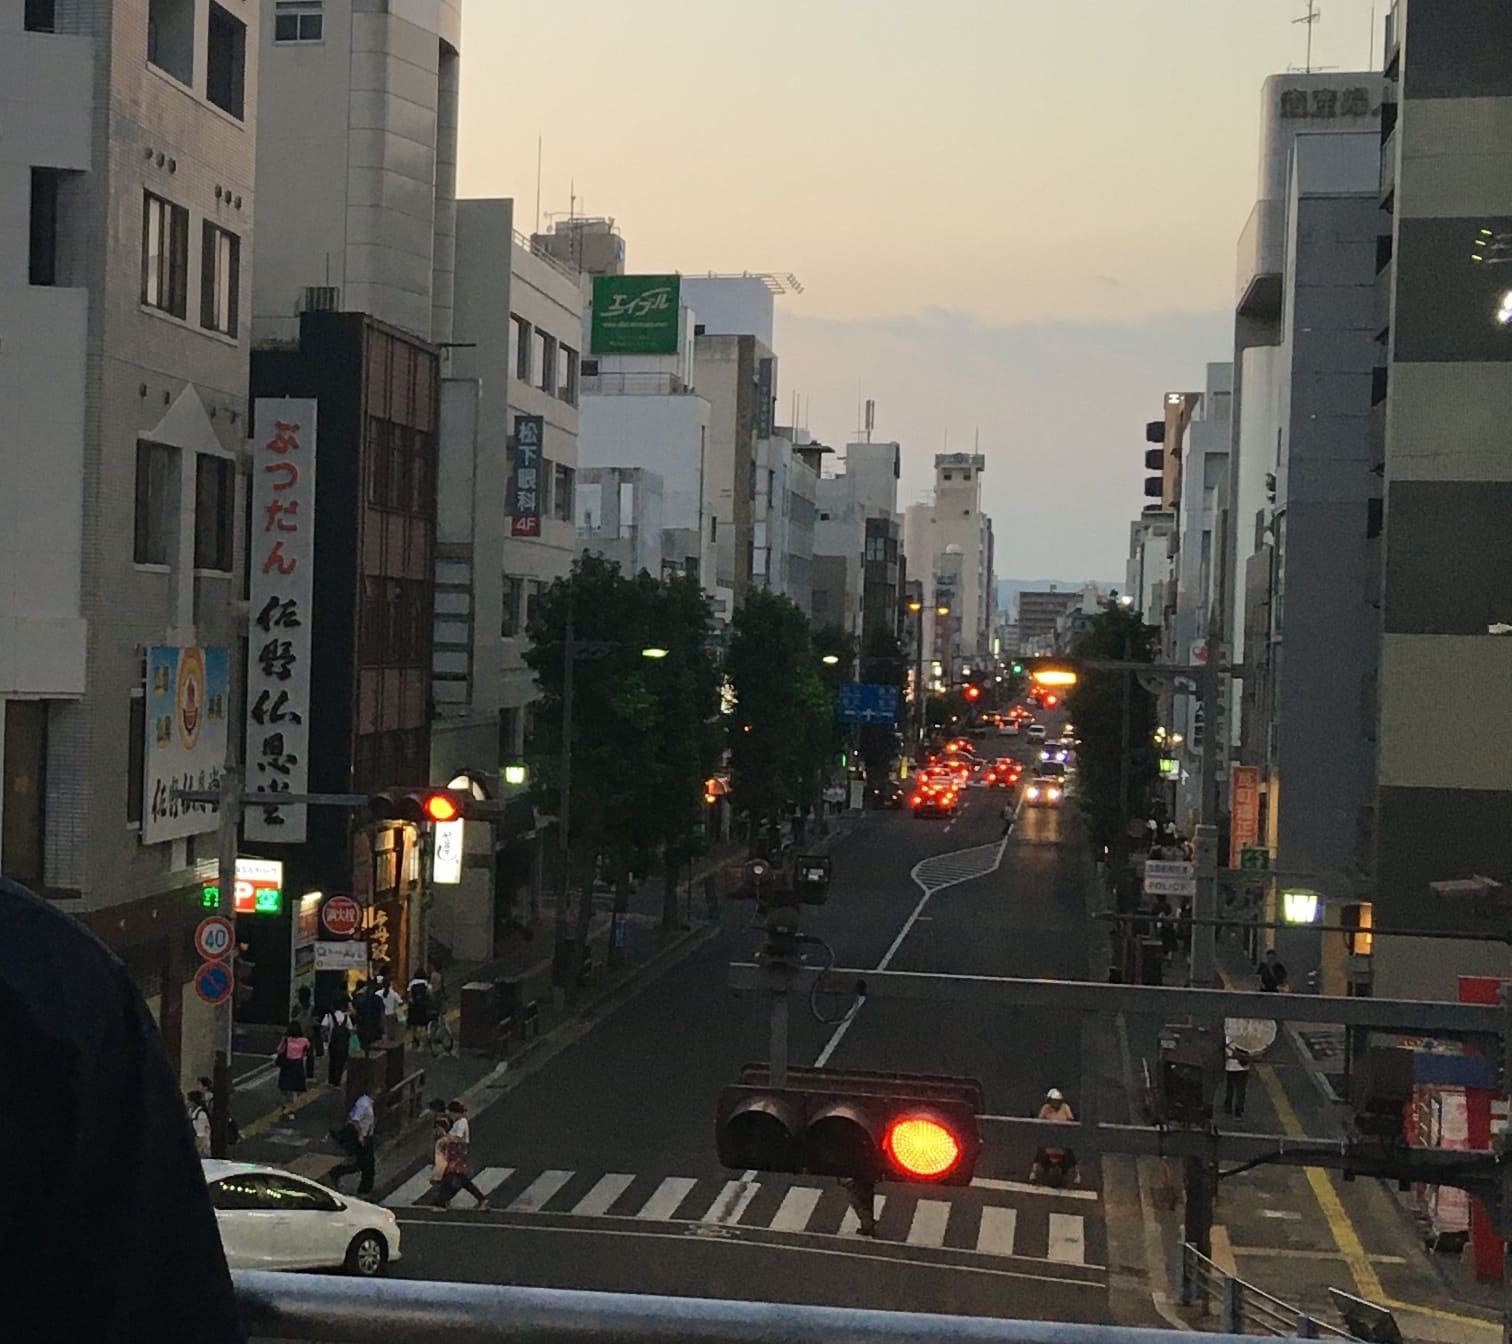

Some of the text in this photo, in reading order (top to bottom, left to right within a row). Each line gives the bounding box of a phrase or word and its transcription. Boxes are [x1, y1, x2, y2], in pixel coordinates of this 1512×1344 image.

[600, 287, 672, 317] エイブル
[517, 421, 538, 512] 松下眼科
[262, 420, 301, 575] ぶつだん
[516, 517, 536, 531] 4F
[204, 927, 227, 948] 40
